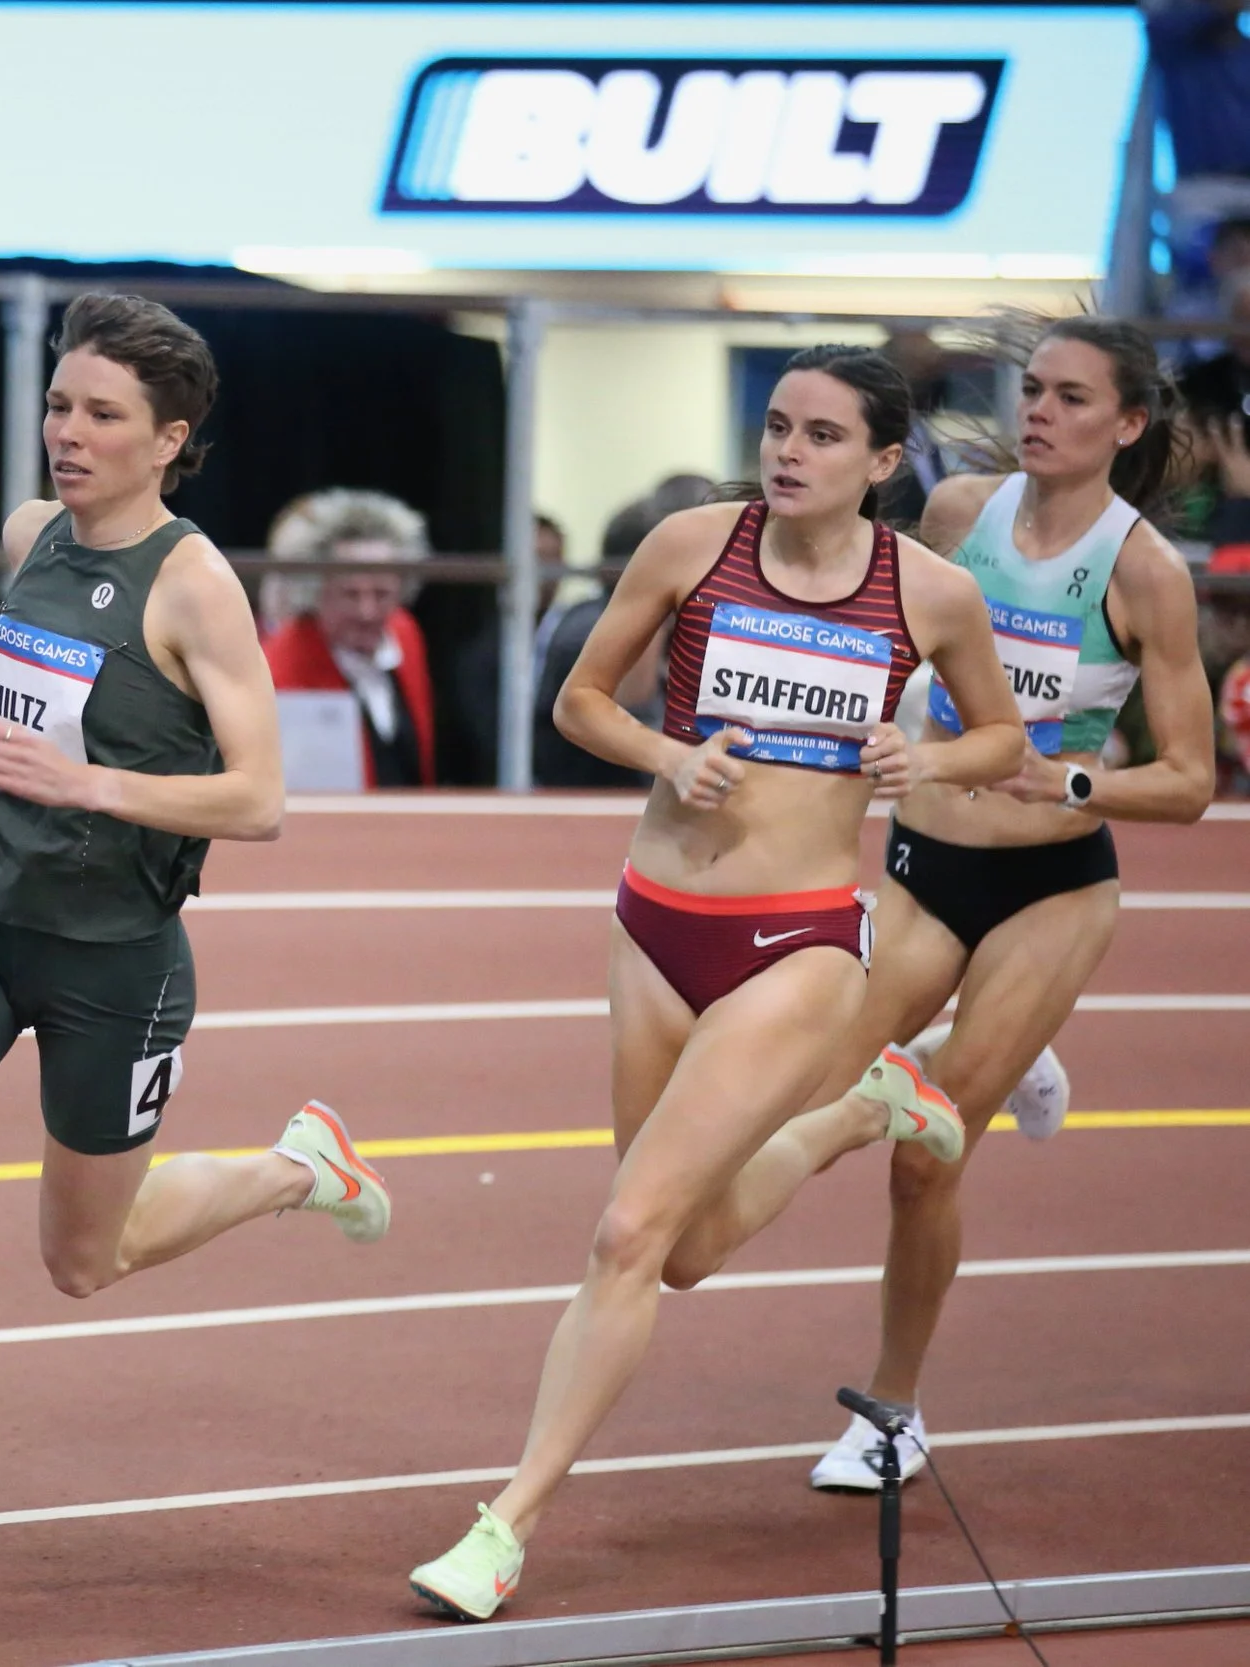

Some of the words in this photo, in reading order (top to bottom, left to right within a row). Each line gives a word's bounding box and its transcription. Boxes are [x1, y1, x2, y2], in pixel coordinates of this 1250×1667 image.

[447, 69, 986, 204] BUILT
[730, 615, 814, 643] MILLROSE
[817, 630, 875, 655] GAMES
[1011, 614, 1067, 639] GAMES
[33, 638, 87, 667] GAMES
[712, 668, 869, 723] STAFFORD
[757, 733, 816, 748] WANAMAKER
[136, 1055, 173, 1119] 4
